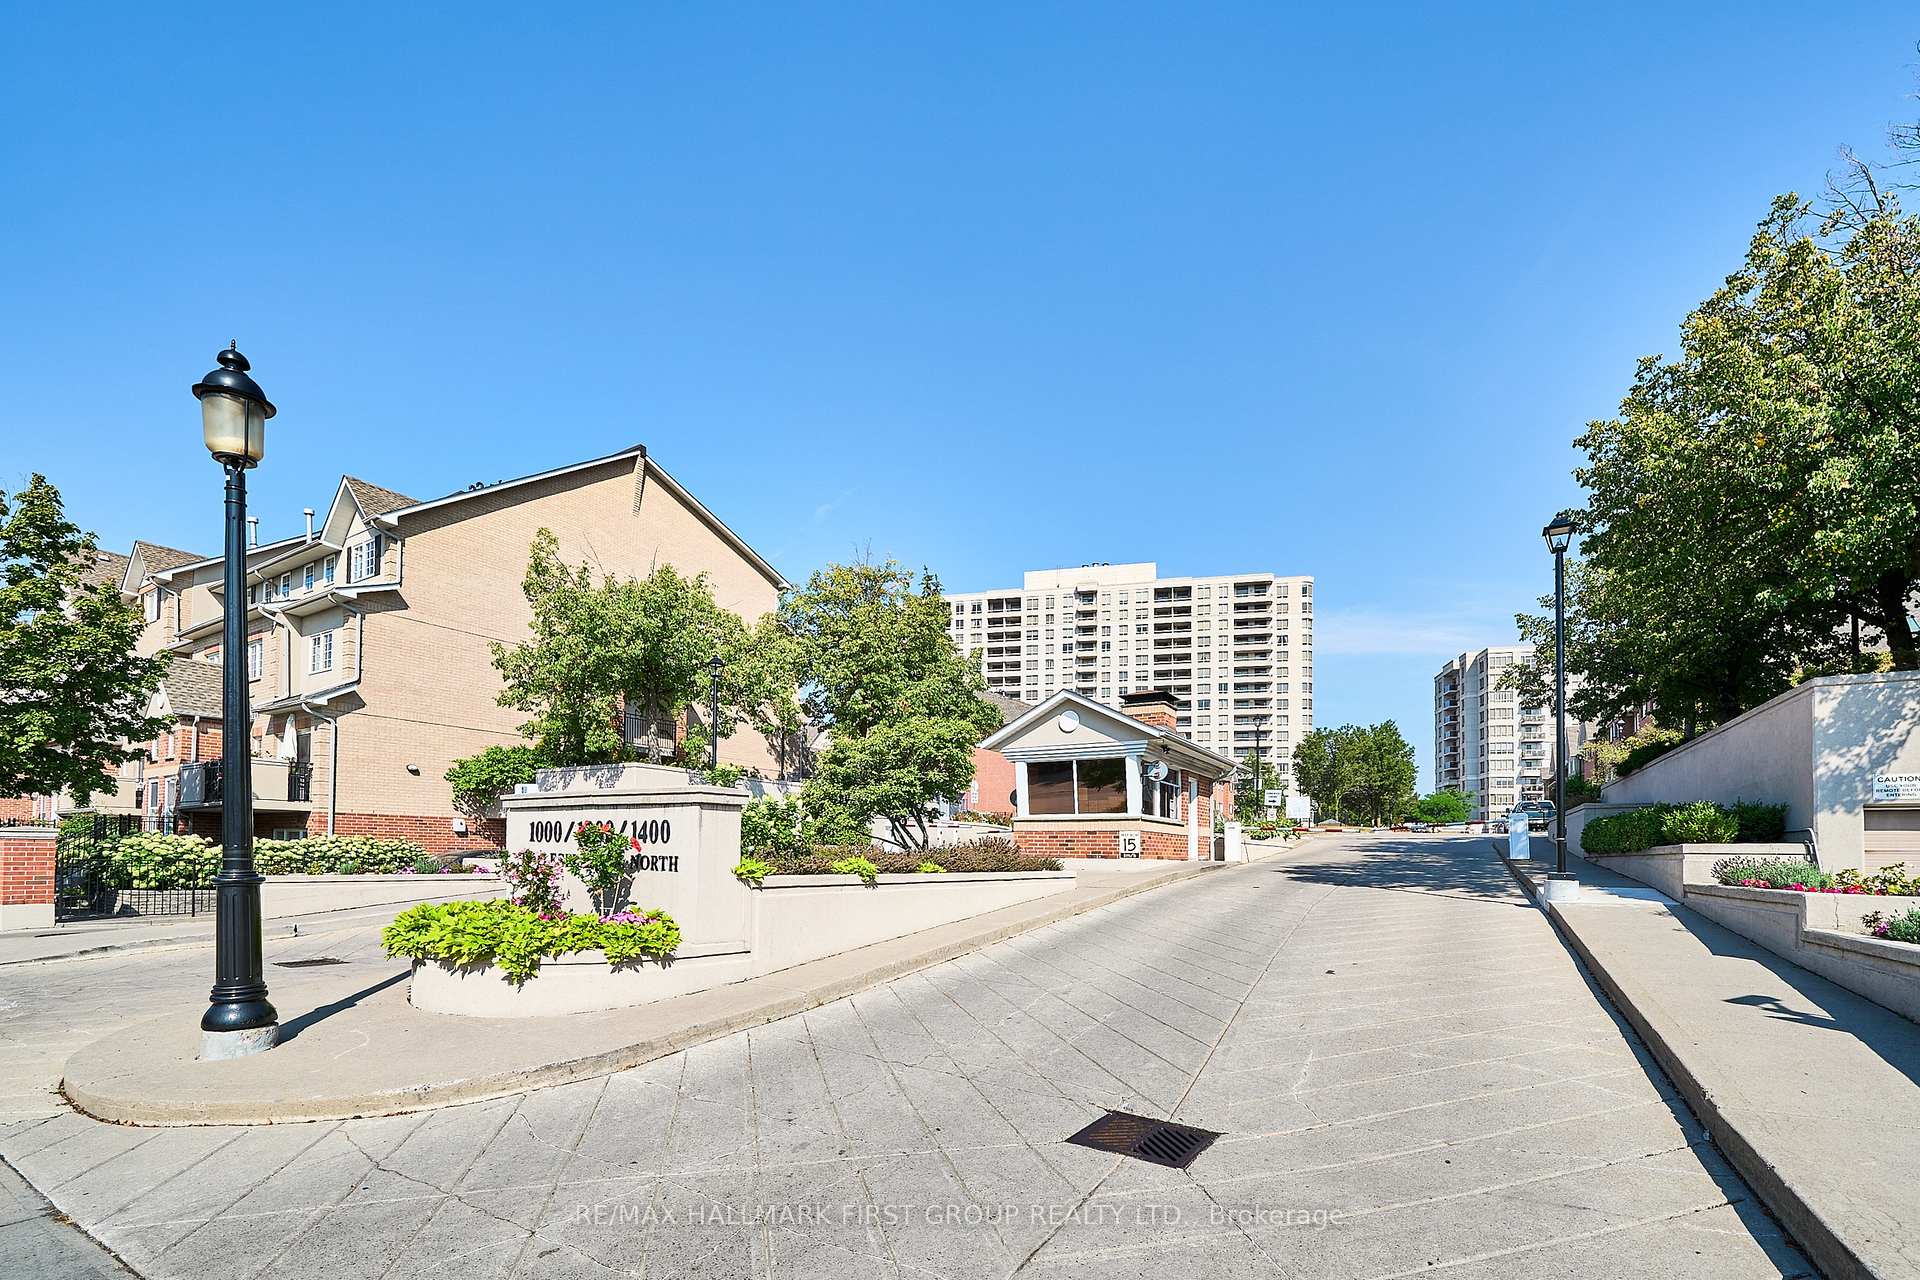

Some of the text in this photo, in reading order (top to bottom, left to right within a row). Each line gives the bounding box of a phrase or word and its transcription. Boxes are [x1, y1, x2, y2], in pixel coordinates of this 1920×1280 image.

[1877, 775, 1920, 783] CAUTION
[1123, 838, 1137, 852] 15
[629, 854, 679, 873] NORTH
